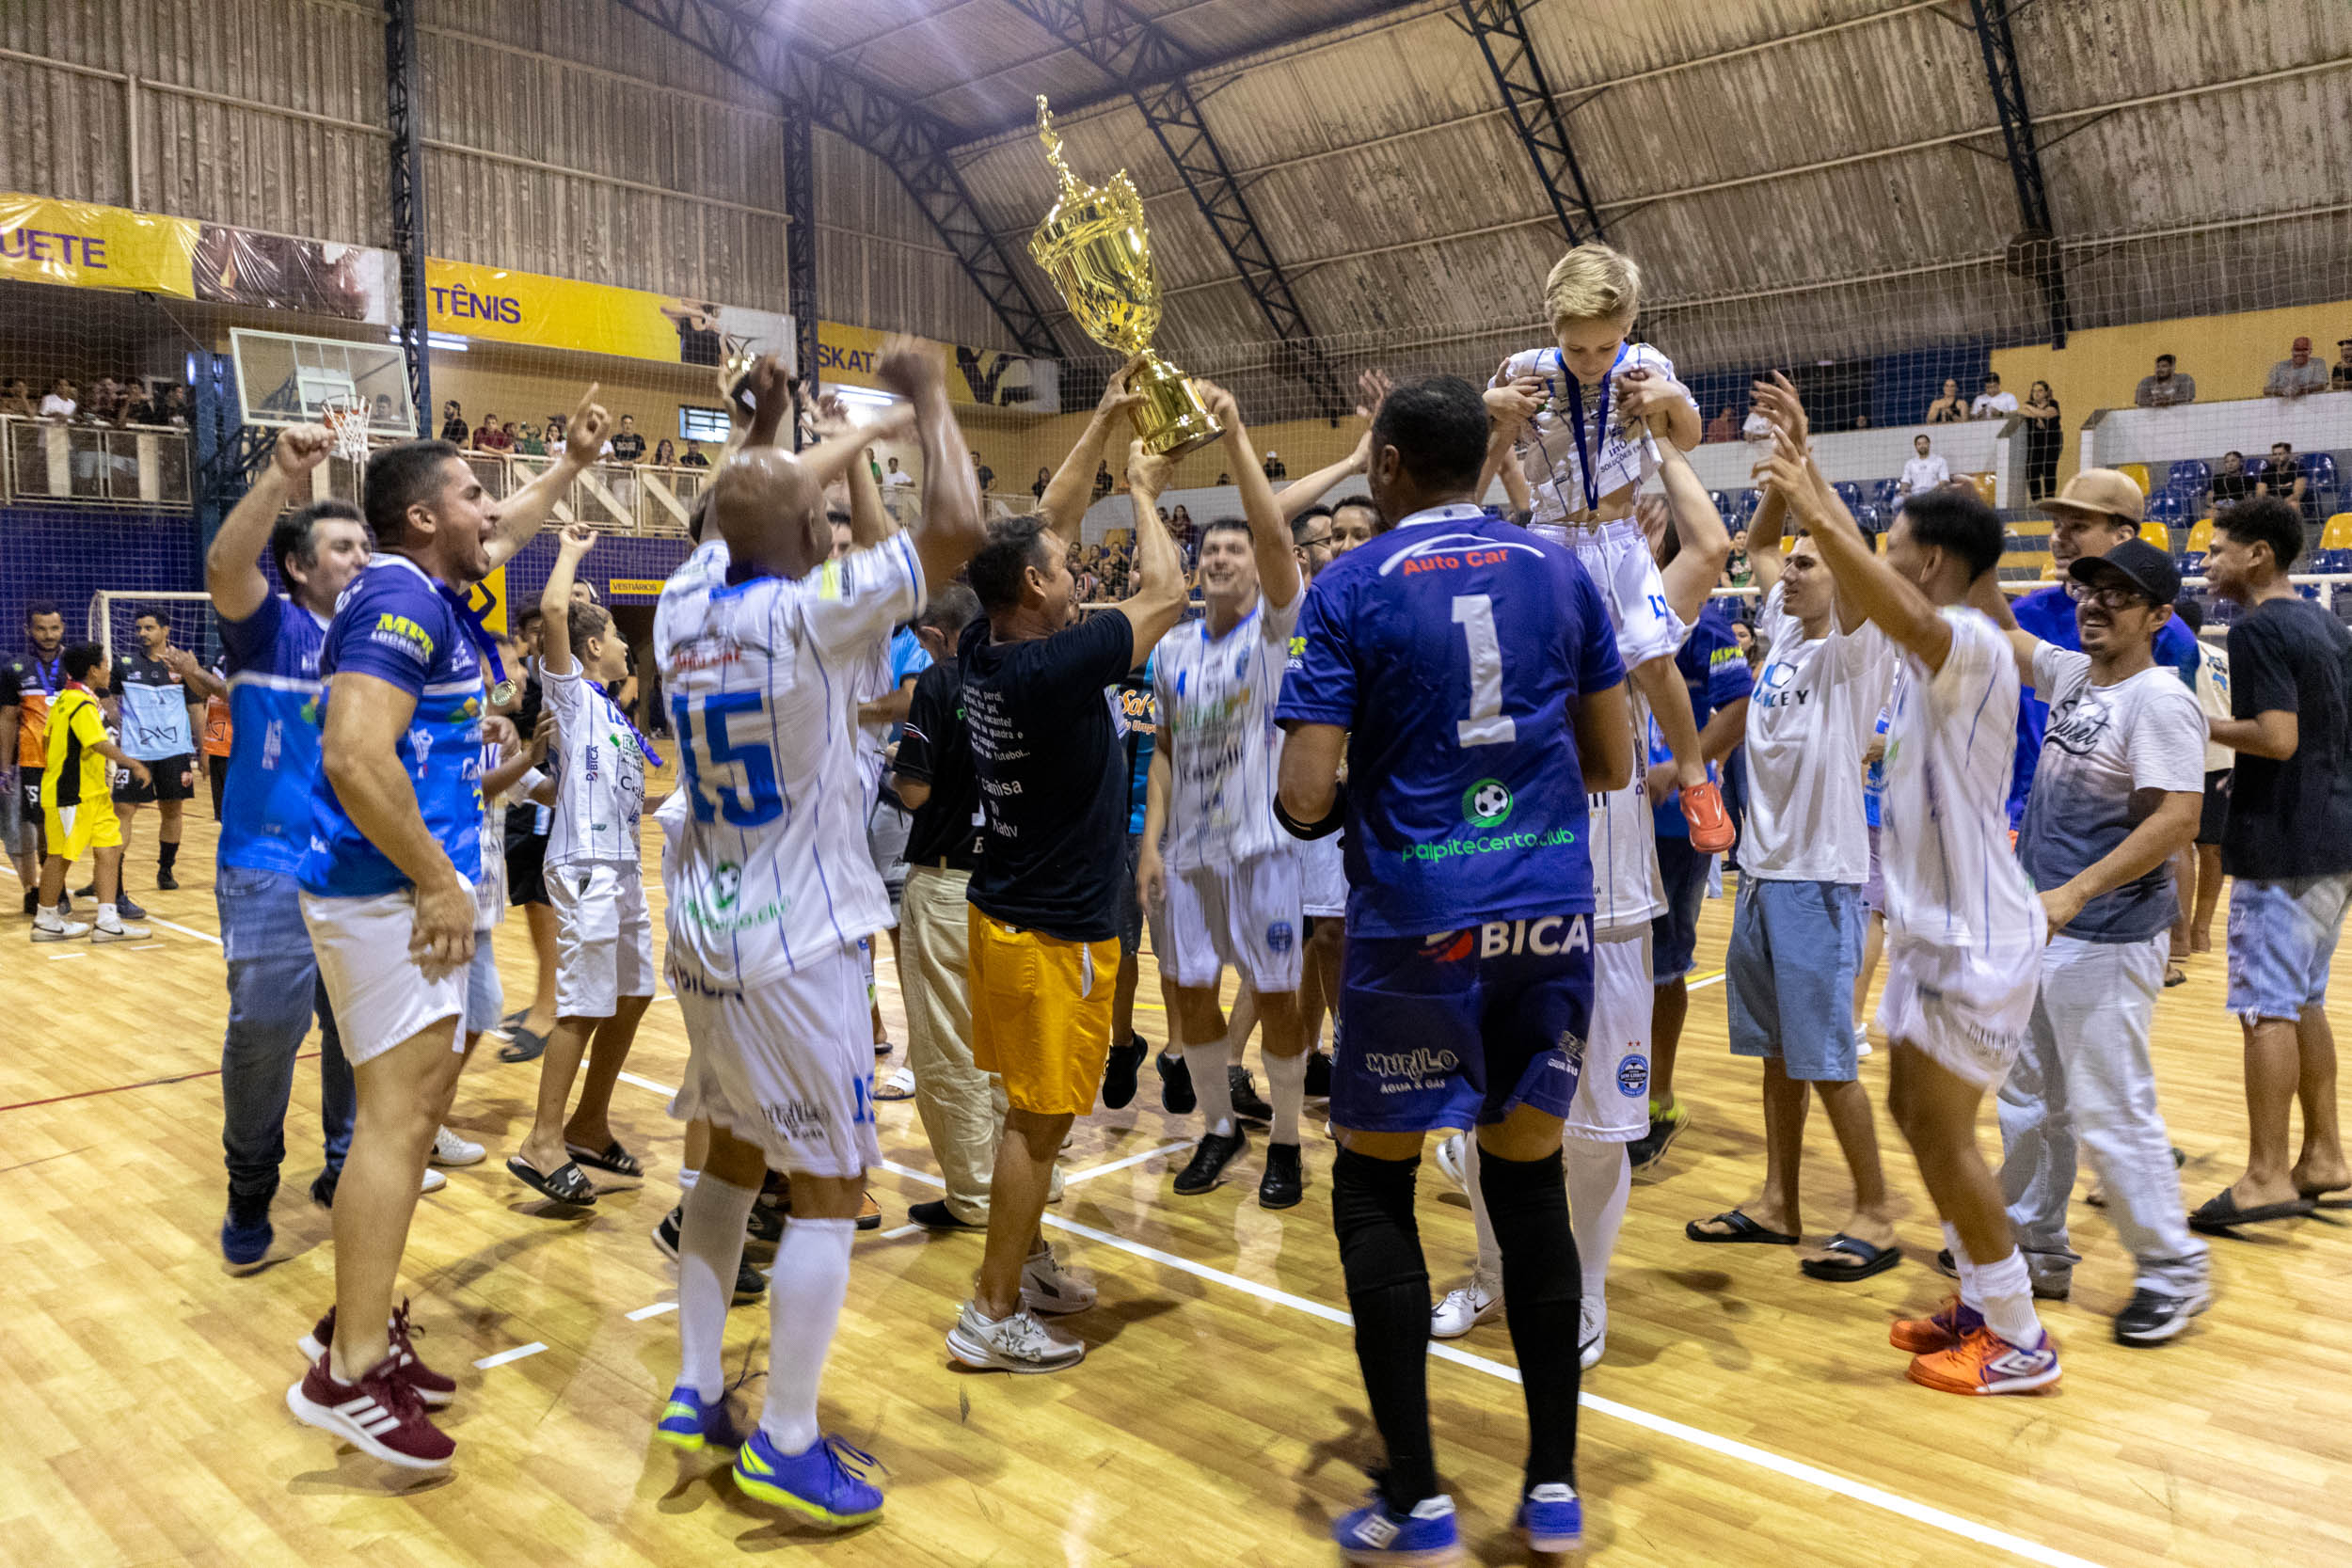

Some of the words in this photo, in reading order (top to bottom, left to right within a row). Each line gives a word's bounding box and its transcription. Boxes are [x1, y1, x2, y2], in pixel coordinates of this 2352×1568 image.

[0, 228, 108, 269] UETE
[429, 282, 522, 324] TÊNIS
[1404, 555, 1460, 576] Auto
[1465, 549, 1509, 568] Car
[1451, 594, 1517, 749] 1
[590, 746, 599, 770] BICA
[672, 688, 784, 828] 15
[981, 778, 1024, 797] camisa
[1480, 913, 1590, 959] BICA
